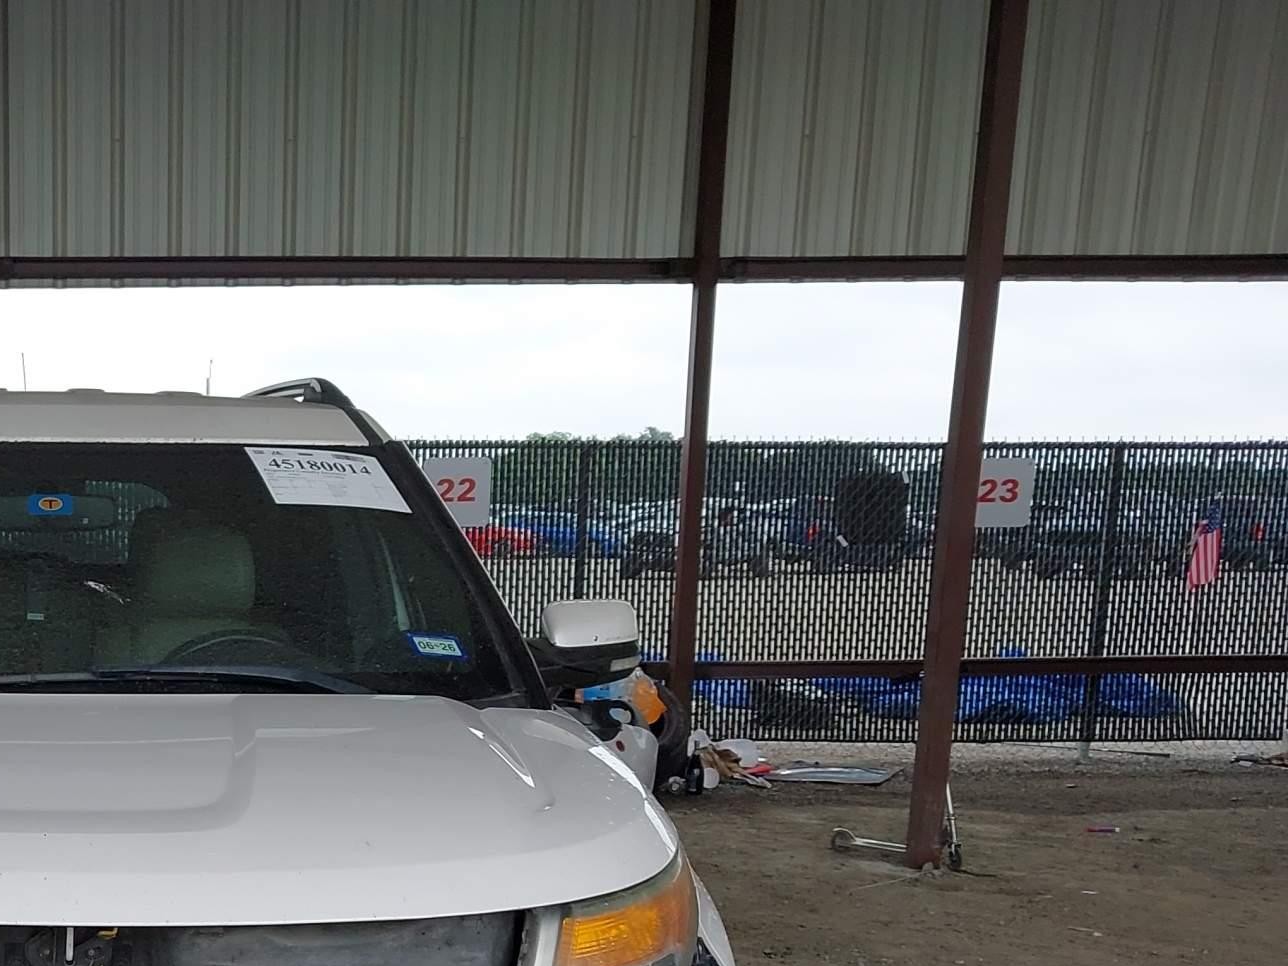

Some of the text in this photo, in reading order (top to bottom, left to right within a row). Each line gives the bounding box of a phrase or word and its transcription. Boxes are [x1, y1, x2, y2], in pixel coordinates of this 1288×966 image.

[268, 457, 372, 475] 45180014
[437, 478, 476, 502] 22
[976, 479, 1019, 503] 23
